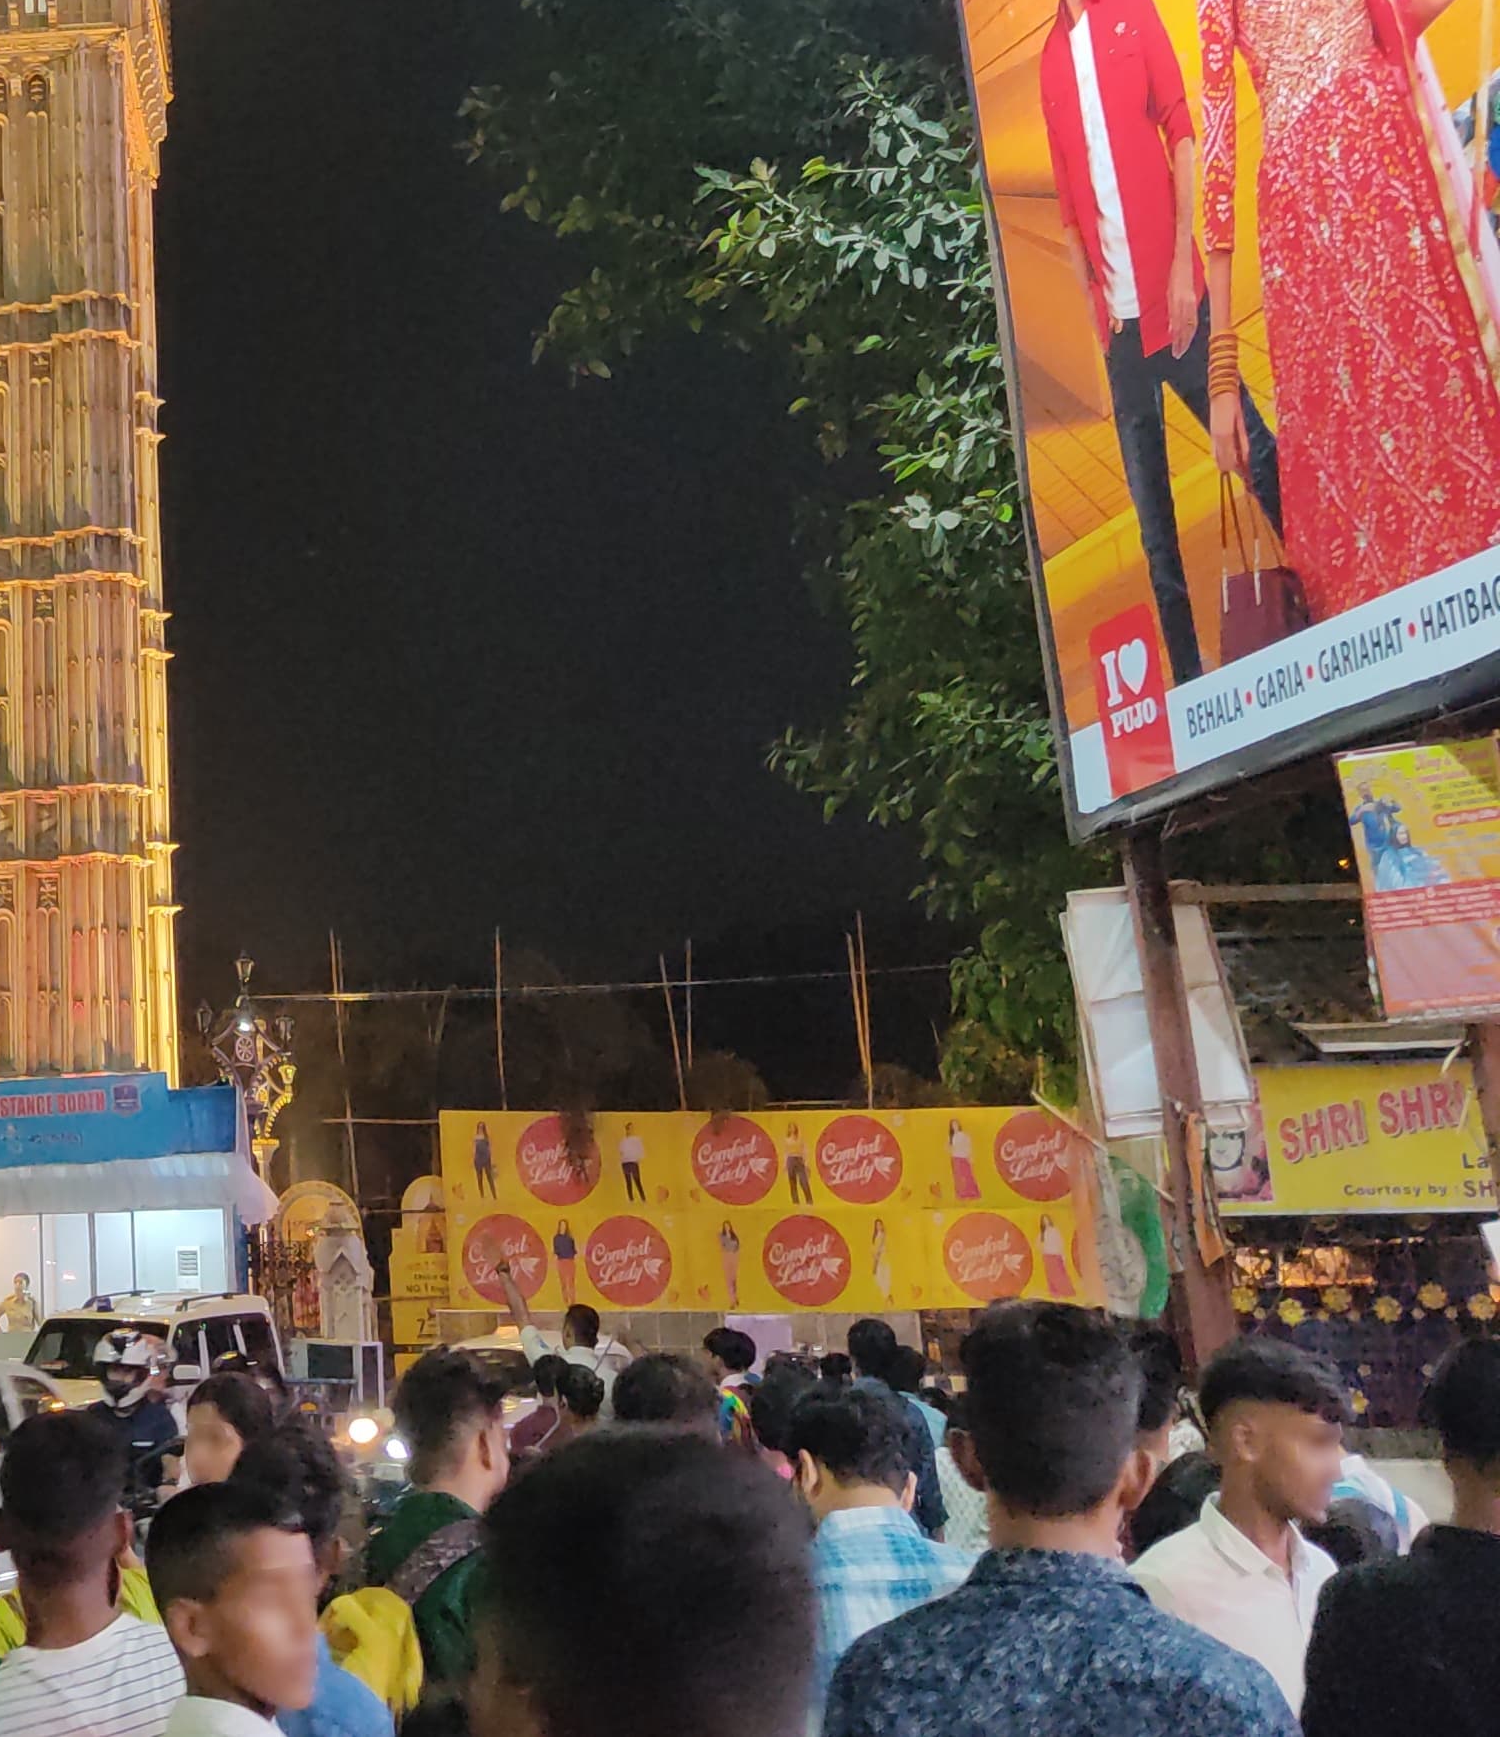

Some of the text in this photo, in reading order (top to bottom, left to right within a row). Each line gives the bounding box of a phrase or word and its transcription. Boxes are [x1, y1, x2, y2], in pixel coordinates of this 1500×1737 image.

[1186, 687, 1245, 740] BEHALA
[1255, 660, 1305, 710] GARIA
[1317, 616, 1404, 684] GARIAHAT
[1110, 695, 1157, 739] PUJO
[56, 1090, 105, 1114] BOOTH
[1279, 1080, 1466, 1164] SHRI SHRI
[698, 1134, 757, 1167] Comfort
[822, 1133, 882, 1166] Comfort
[1001, 1129, 1062, 1162] Comfort
[703, 1158, 750, 1187] Lady
[827, 1158, 876, 1185] Lady
[1009, 1156, 1056, 1182] Lady
[1343, 1183, 1421, 1198] Courtesy
[1427, 1184, 1447, 1198] by
[592, 1235, 652, 1267] Comfort
[769, 1233, 831, 1267] Comfort
[949, 1230, 1011, 1264] Comfort
[596, 1259, 644, 1287] Lady
[775, 1258, 824, 1287] Lady
[958, 1256, 1004, 1283] Lady
